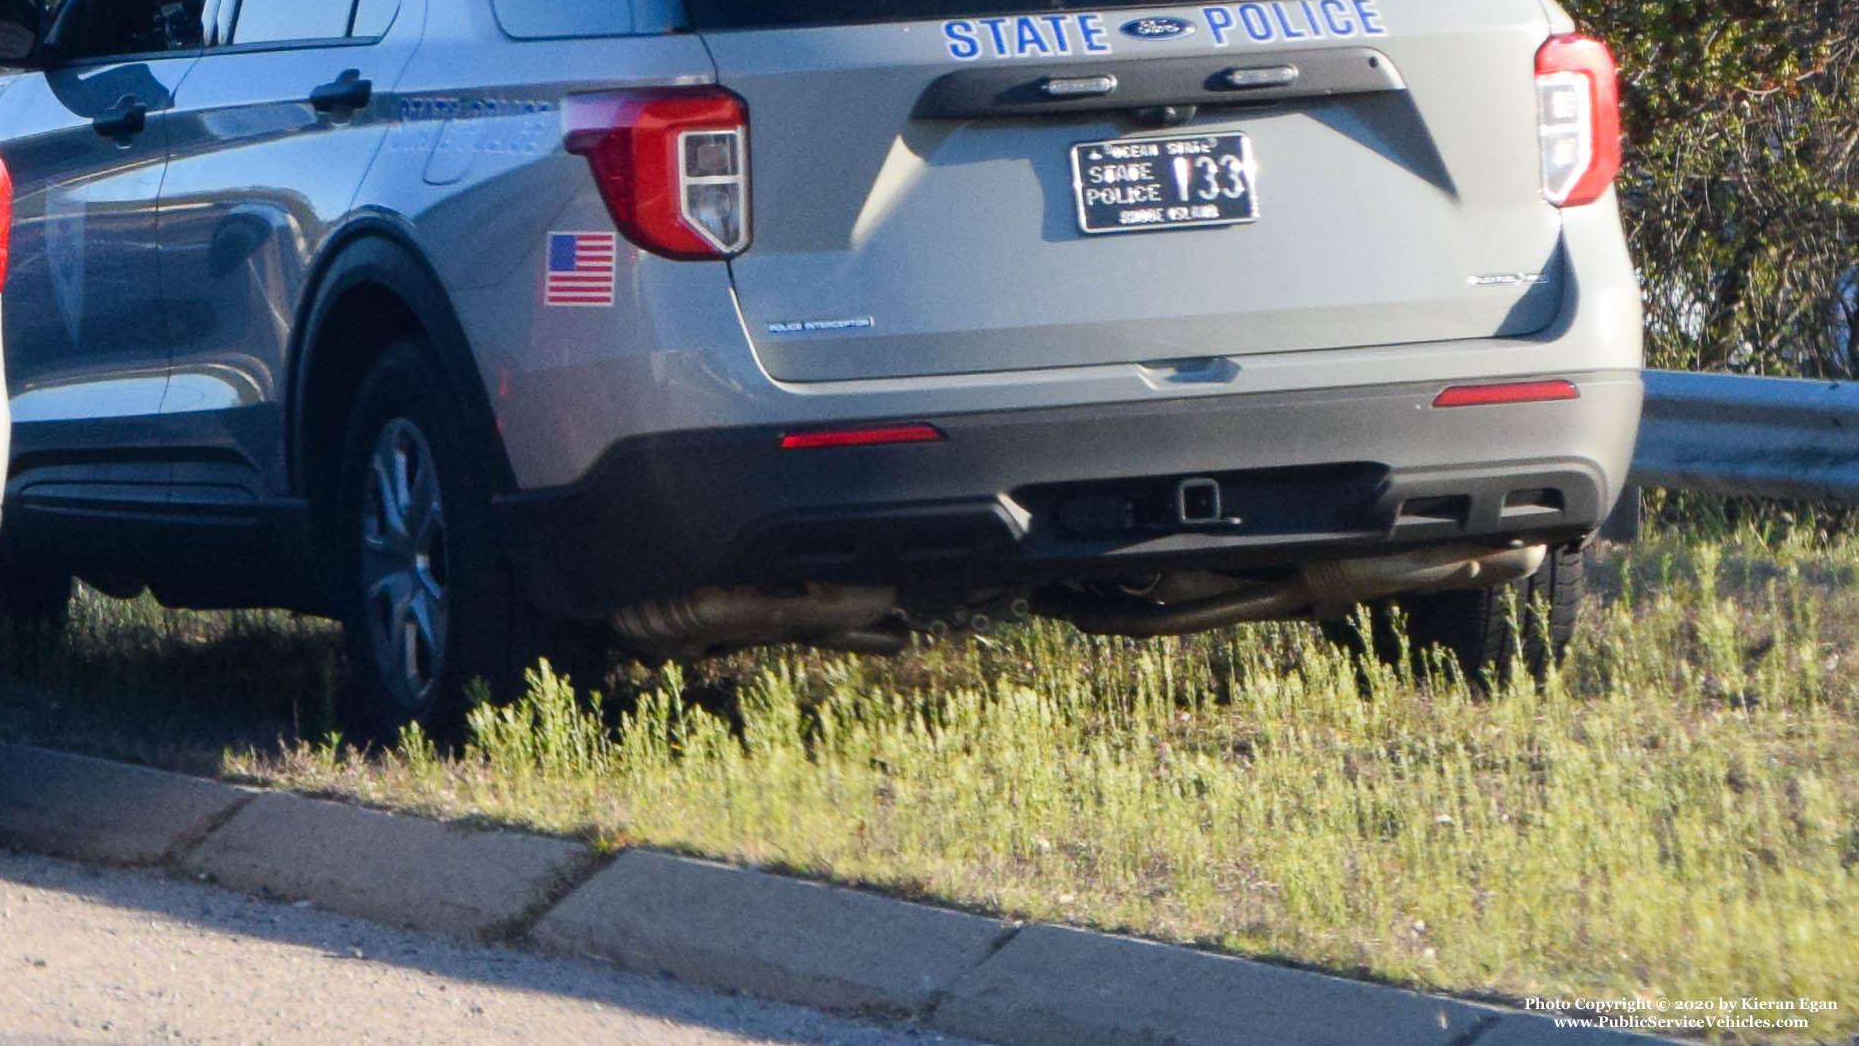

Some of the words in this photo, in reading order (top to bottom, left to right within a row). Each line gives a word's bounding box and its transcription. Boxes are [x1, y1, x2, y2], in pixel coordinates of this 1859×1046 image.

[943, 14, 1109, 59] STATE
[1086, 184, 1162, 205] POLICE
[1089, 162, 1154, 183] STATE
[1173, 154, 1245, 202] 133
